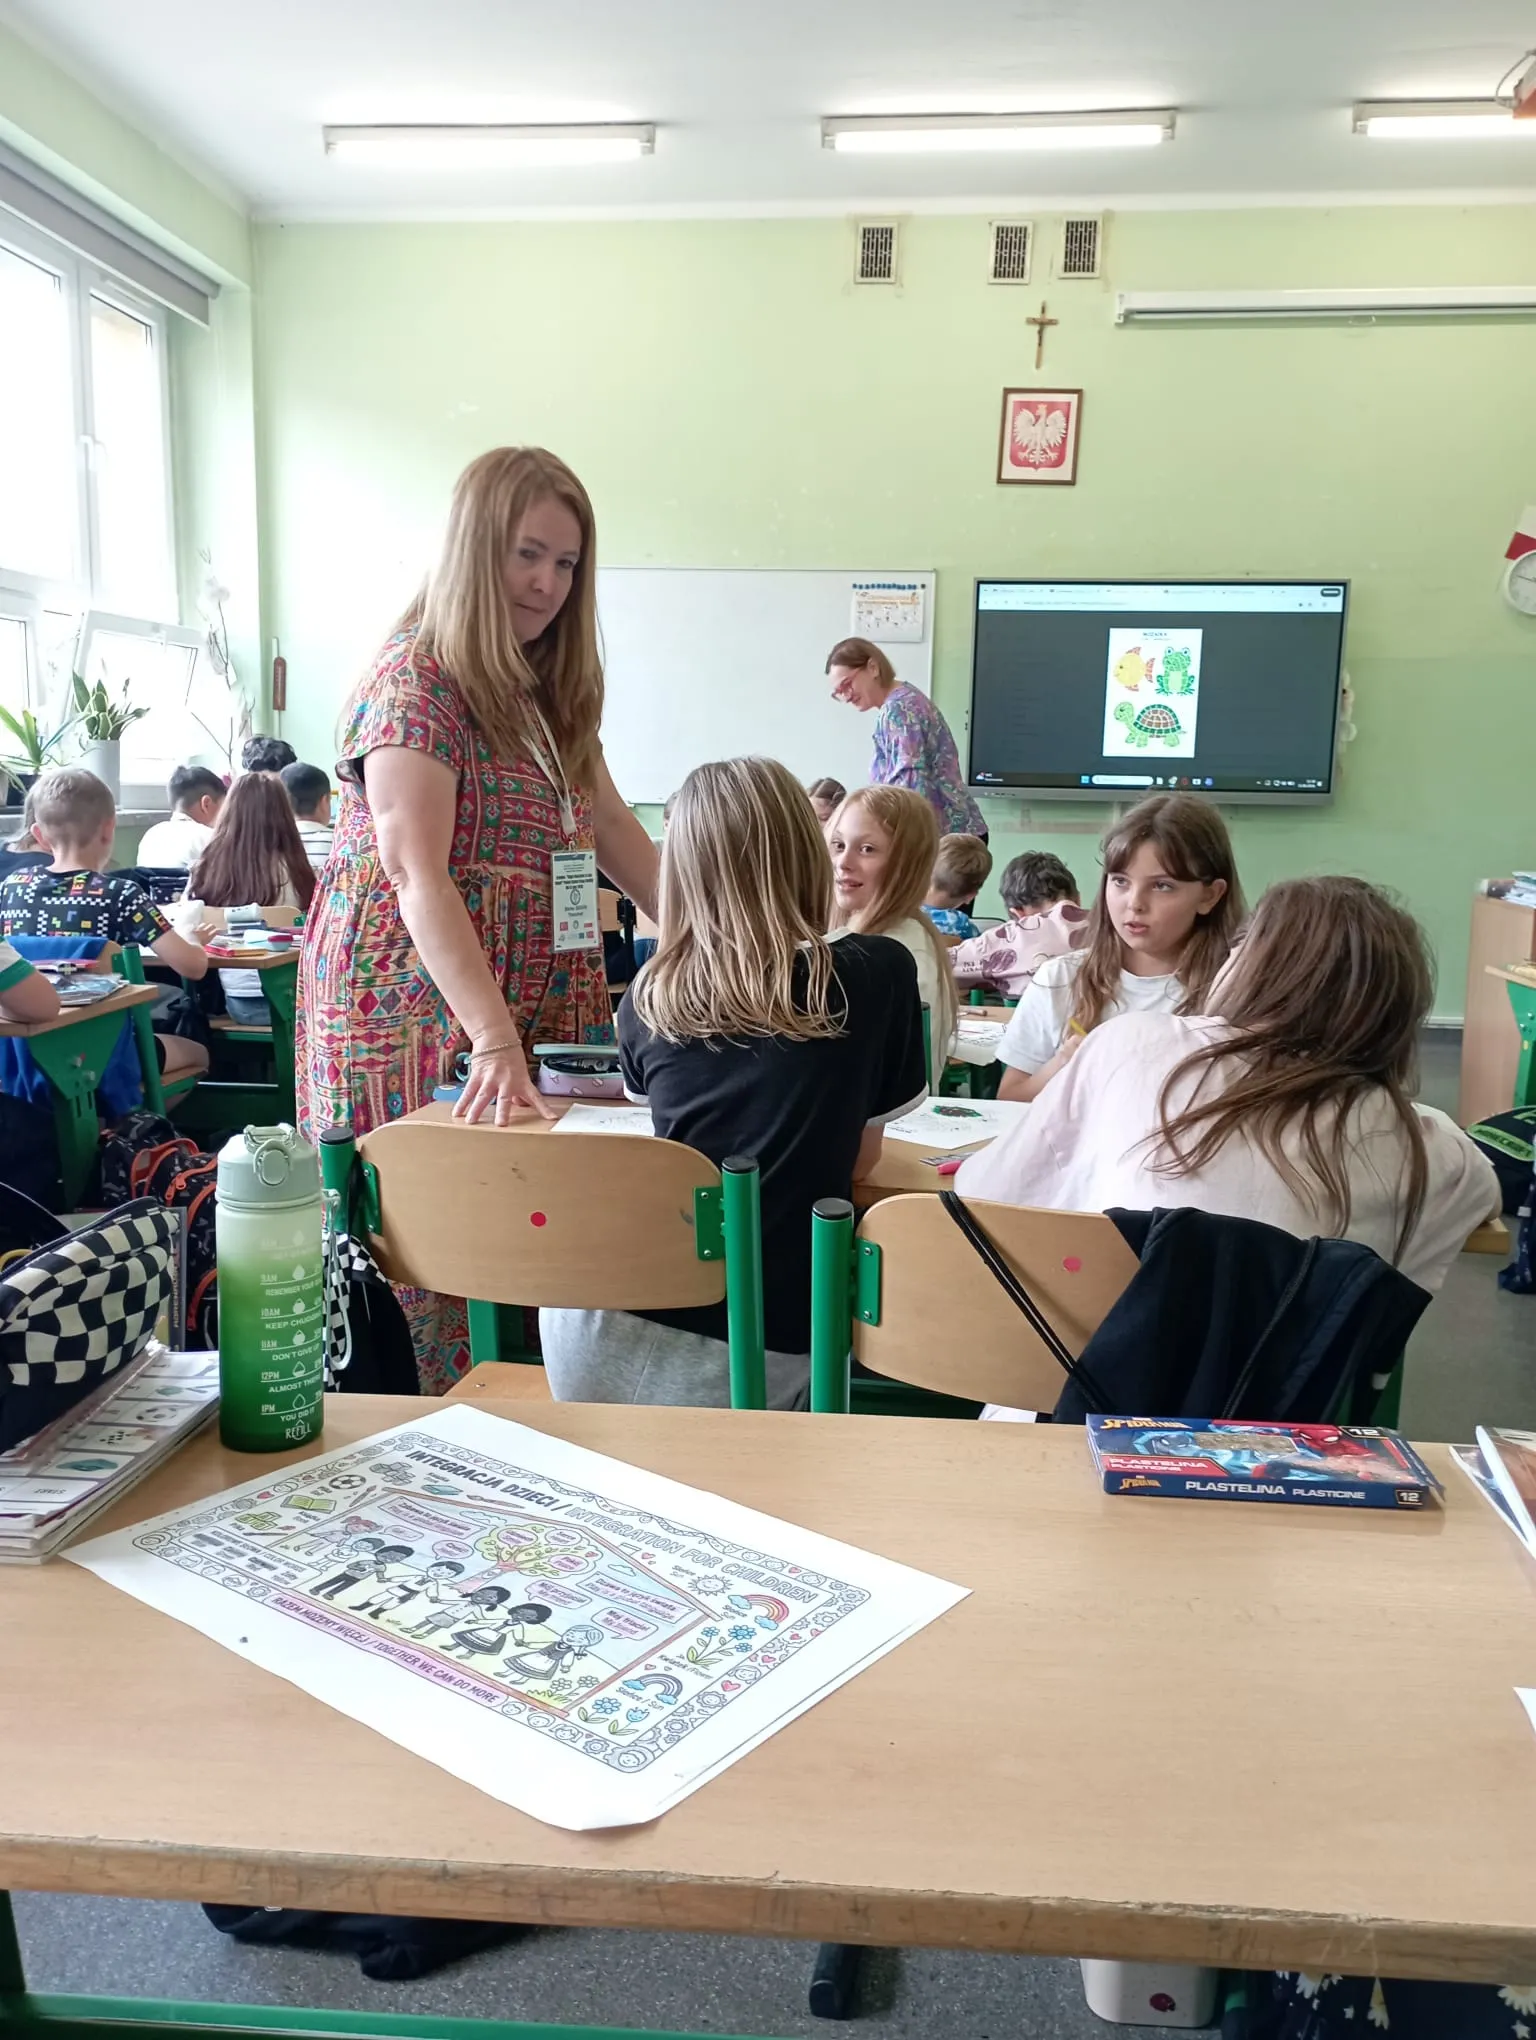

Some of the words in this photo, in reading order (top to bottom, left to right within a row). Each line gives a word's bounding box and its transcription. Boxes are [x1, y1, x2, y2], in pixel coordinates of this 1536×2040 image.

[265, 1321, 289, 1330] KEEP
[261, 1371, 280, 1380] 12PM
[268, 1382, 302, 1393] ALMOST
[261, 1404, 275, 1413] 1PM
[280, 1413, 297, 1422] YOU
[298, 1409, 310, 1418] DID
[285, 1423, 312, 1439] REFILL
[1349, 1428, 1381, 1436] 12
[1109, 1458, 1209, 1469] PLASTELINA
[1185, 1480, 1286, 1495] PLASTELINA
[1292, 1488, 1367, 1500] PLASTICINE
[1400, 1492, 1420, 1502] 12
[405, 1450, 504, 1489] INTEGRACJA
[501, 1483, 560, 1508] DZIECI
[564, 1507, 685, 1554] INTEGRATION
[680, 1548, 723, 1569] FOR
[721, 1563, 819, 1604] CHILDREN
[272, 1597, 305, 1615] RAZEM
[302, 1609, 338, 1628] MOŻEMY
[334, 1624, 370, 1643] WIĘCEJ
[373, 1642, 421, 1666] TOGETHER
[418, 1661, 437, 1673] WE
[433, 1669, 456, 1683] CAN
[453, 1679, 471, 1690] DO
[468, 1686, 500, 1703] MORE
